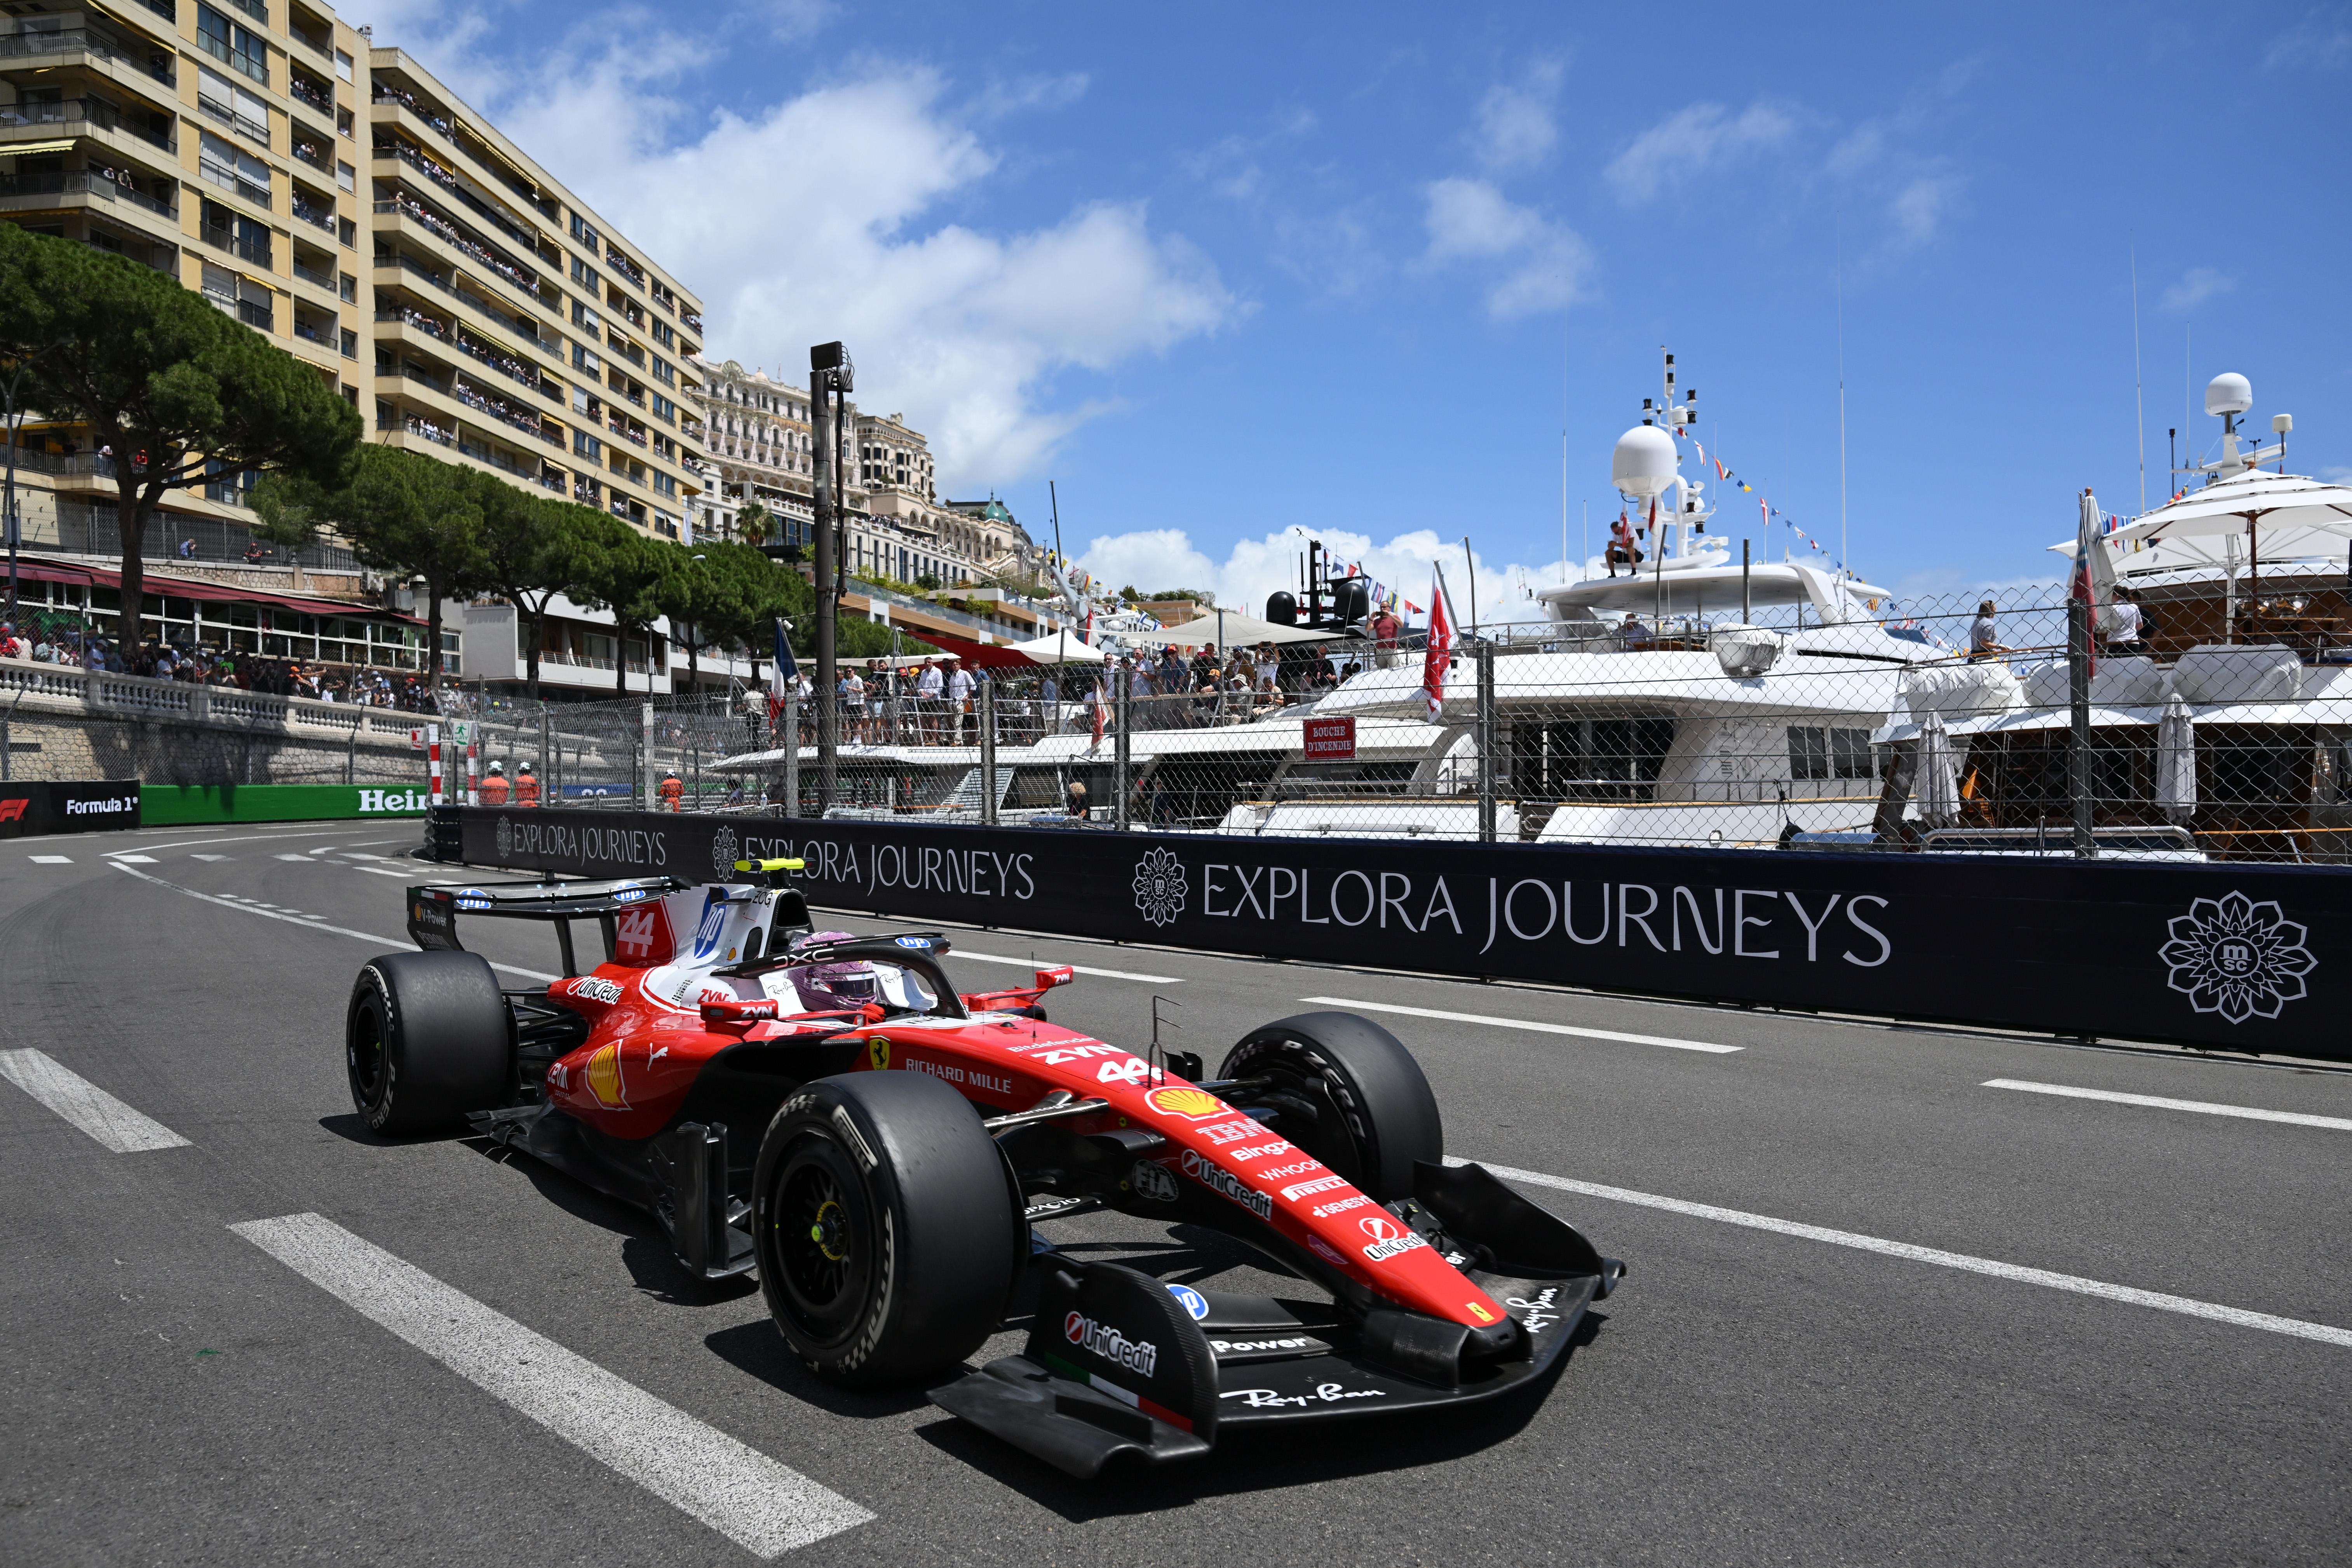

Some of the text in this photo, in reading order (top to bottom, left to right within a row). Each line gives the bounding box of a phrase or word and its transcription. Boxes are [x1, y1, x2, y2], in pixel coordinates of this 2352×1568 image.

[1313, 726, 1345, 737] BOUCHE
[1308, 740, 1352, 751] D'INCENDIE
[67, 798, 122, 814] Formula
[514, 824, 666, 867] EXPLORA JOURNEYS
[867, 844, 1034, 900] JOURNEYS
[752, 890, 773, 906] ZCG
[421, 908, 446, 927] V-Power
[1204, 864, 1892, 967] EXPLORA JOURNEYS
[618, 911, 655, 957] 44
[773, 948, 835, 969] DXC
[1054, 973, 1070, 985] ZYN
[697, 988, 728, 1005] ZYN
[741, 1006, 772, 1018] ZYN
[1007, 1037, 1096, 1052] Bitdefender
[1030, 1044, 1128, 1065] ZYN
[906, 1058, 1011, 1094] RICHARD MILLE
[1096, 1058, 1167, 1085] 44
[1195, 1118, 1274, 1145] IBM
[1257, 1160, 1324, 1181] WHOOP
[1199, 1158, 1273, 1221] UniCredit
[1322, 1195, 1377, 1214] GENESYS
[1082, 1318, 1157, 1378] UniCredit
[1209, 1336, 1308, 1353] Power
